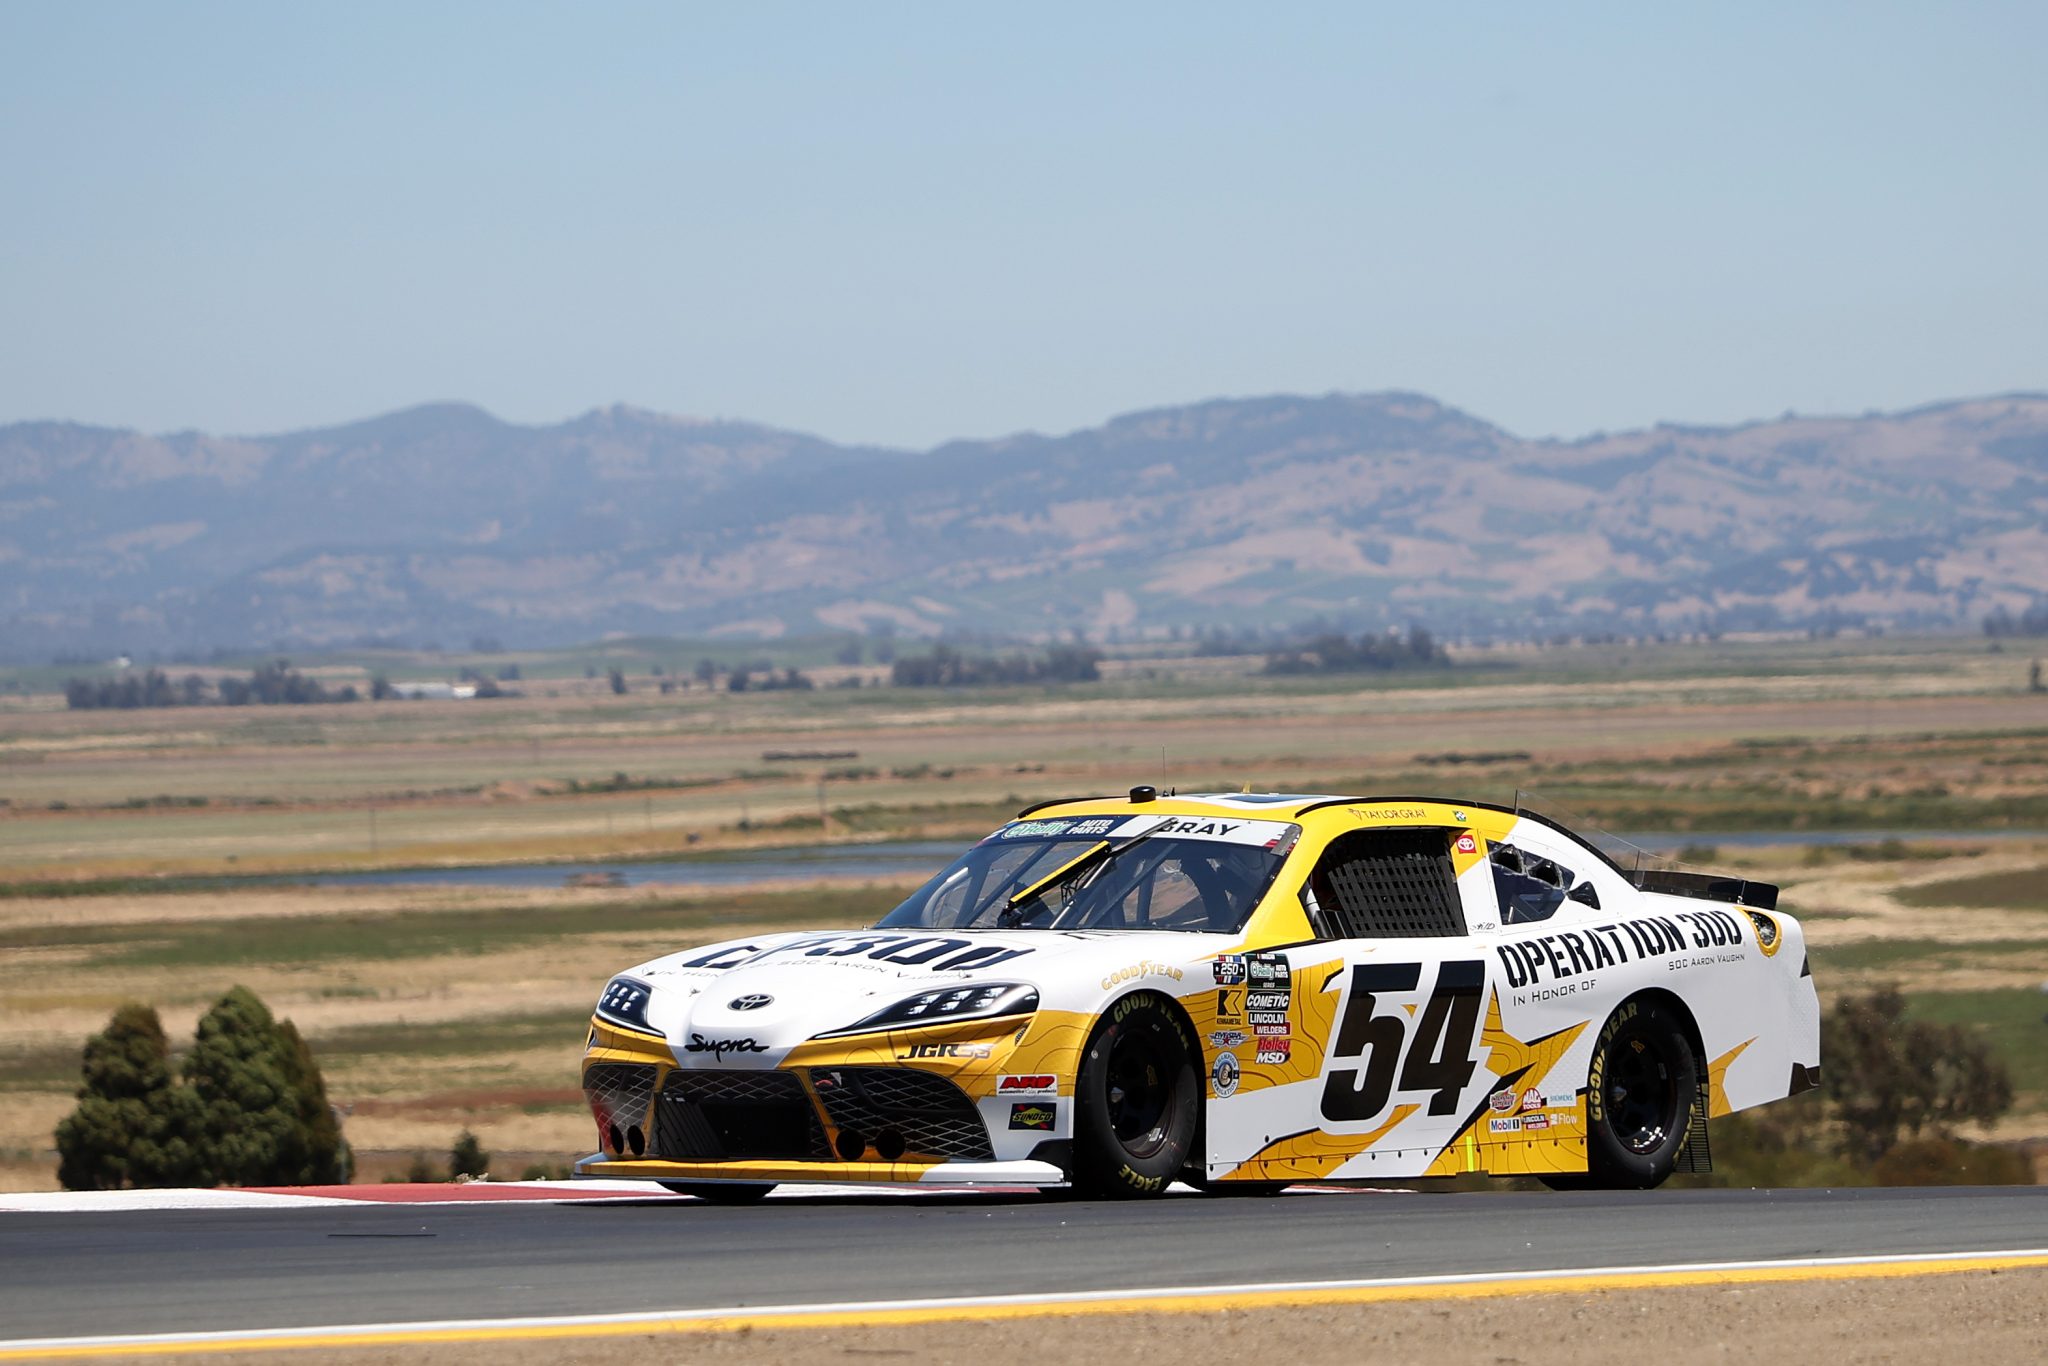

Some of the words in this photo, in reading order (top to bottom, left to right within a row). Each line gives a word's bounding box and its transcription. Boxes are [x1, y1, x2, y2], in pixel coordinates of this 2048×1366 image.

[1066, 826, 1109, 835] PARTS
[1078, 819, 1114, 828] AUTO
[1497, 916, 1687, 988] OPERATION
[1675, 909, 1743, 948] 300
[1691, 956, 1717, 967] AARON
[1717, 953, 1746, 965] VAUGHN
[1101, 960, 1184, 991] GOODYEAR
[1220, 963, 1239, 976] 250
[1246, 992, 1290, 1007] COMETIC
[1513, 995, 1526, 1007] IN
[1531, 984, 1577, 1003] HONOR
[1581, 979, 1597, 991] OF
[1249, 1013, 1284, 1024] LINCOLN
[1256, 1025, 1287, 1034] WELDERS
[684, 1033, 770, 1063] Supra
[1257, 1036, 1290, 1053] Holley
[1320, 960, 1485, 1122] 54
[1255, 1052, 1286, 1064] MSD
[999, 1075, 1055, 1089] ARP
[1013, 1112, 1053, 1122] SUNOCO
[1558, 1114, 1578, 1124] Flow
[1491, 1120, 1511, 1131] Mobil
[1118, 1163, 1163, 1192] EAGLE
